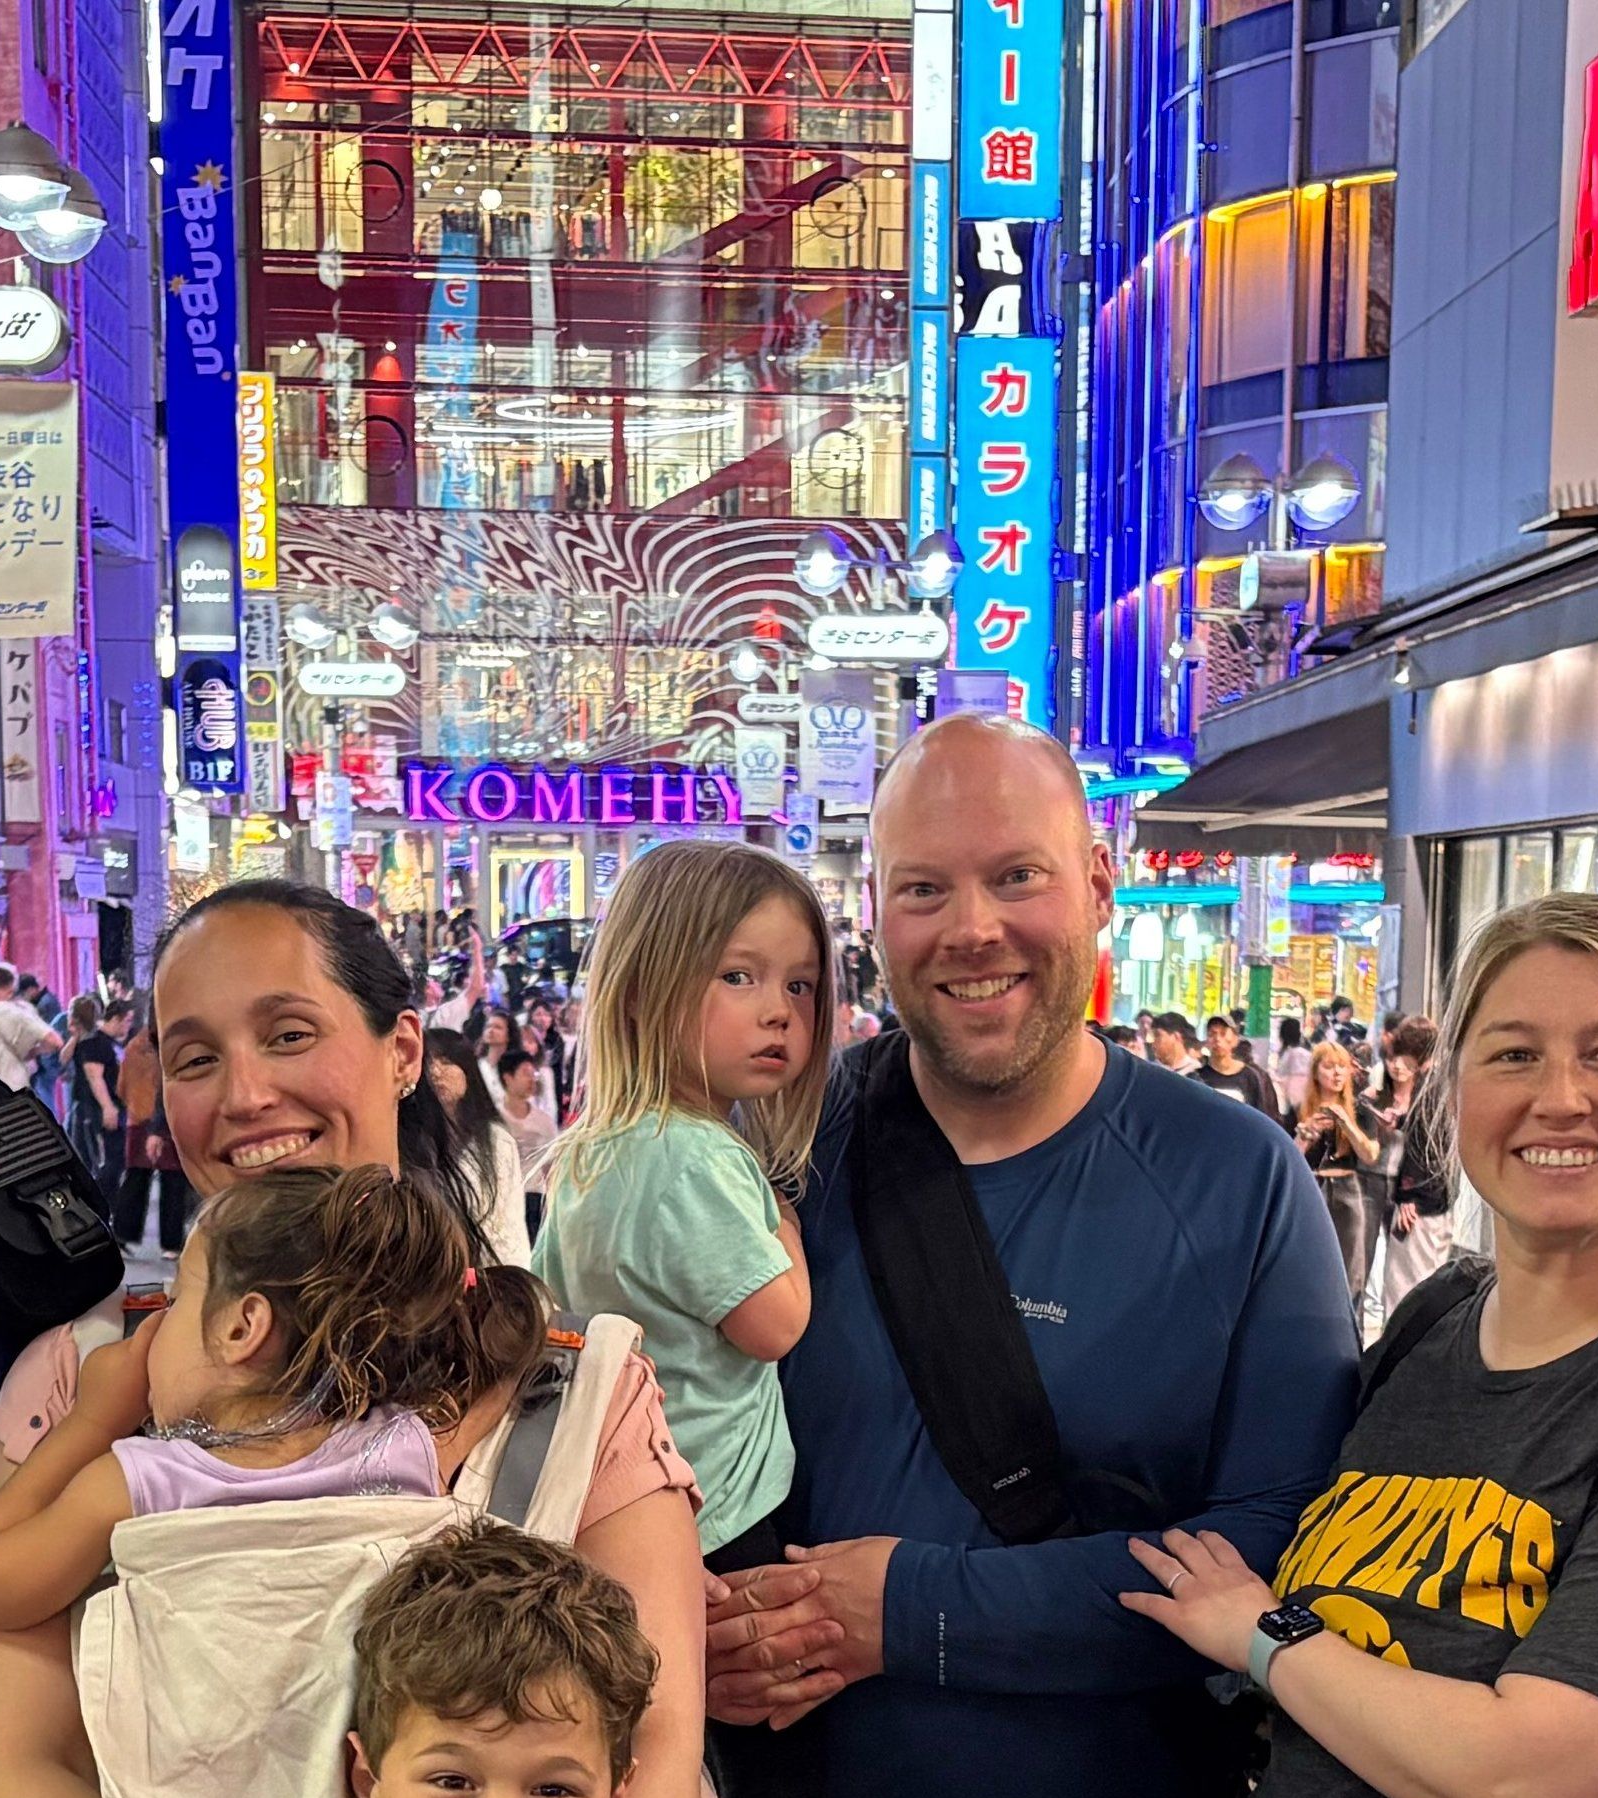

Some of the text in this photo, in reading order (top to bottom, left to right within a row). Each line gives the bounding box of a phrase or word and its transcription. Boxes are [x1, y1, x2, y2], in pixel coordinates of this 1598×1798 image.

[177, 182, 225, 375] BanBan
[6, 650, 35, 737] ケバブ
[193, 678, 236, 752] HUB
[189, 761, 235, 781] B1F
[407, 768, 791, 827] KOMEHY
